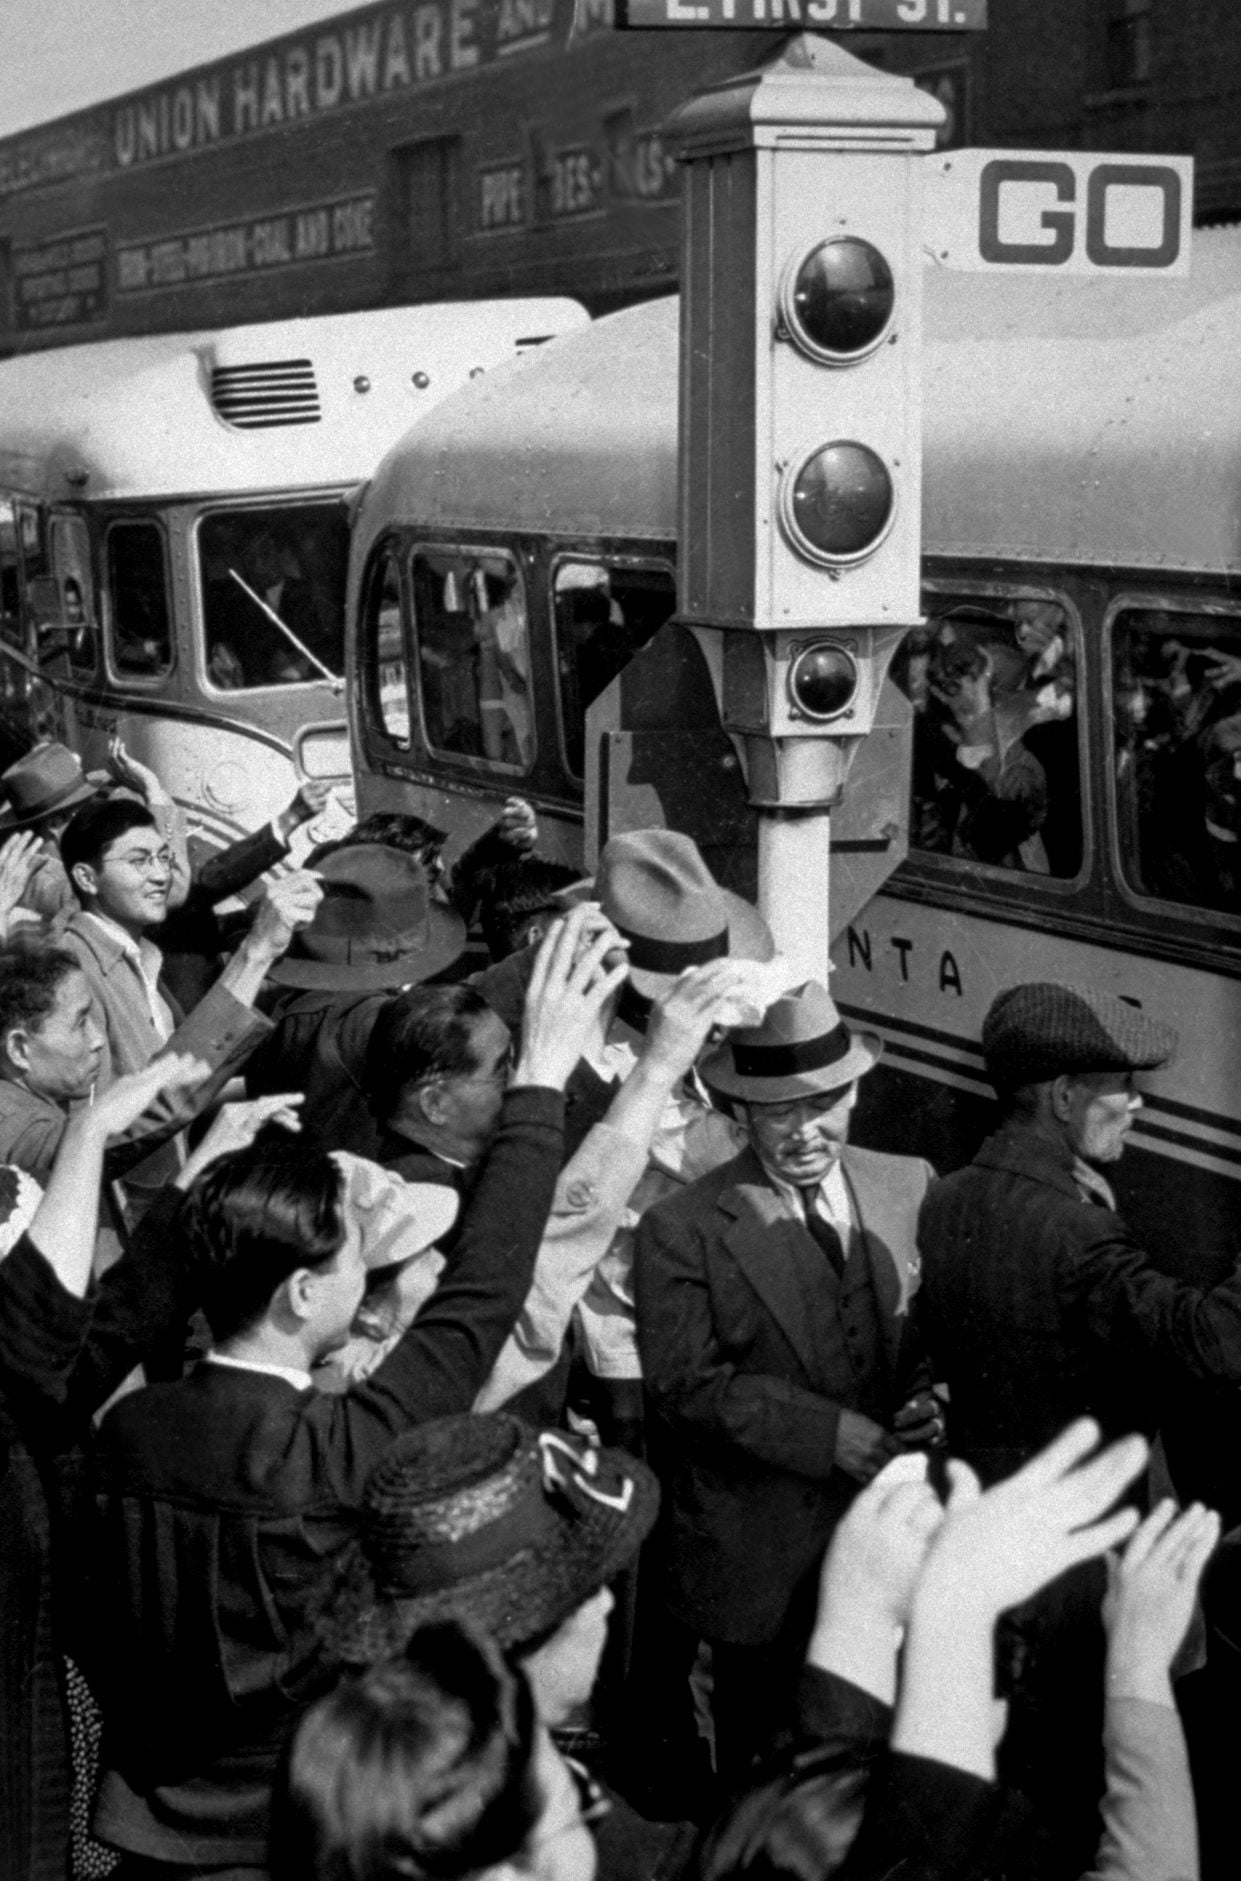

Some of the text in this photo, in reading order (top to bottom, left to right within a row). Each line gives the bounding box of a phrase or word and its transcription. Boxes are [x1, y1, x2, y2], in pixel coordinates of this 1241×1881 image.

[116, 78, 220, 166] UNION
[234, 0, 479, 132] HARDWARE
[979, 159, 1182, 268] GO
